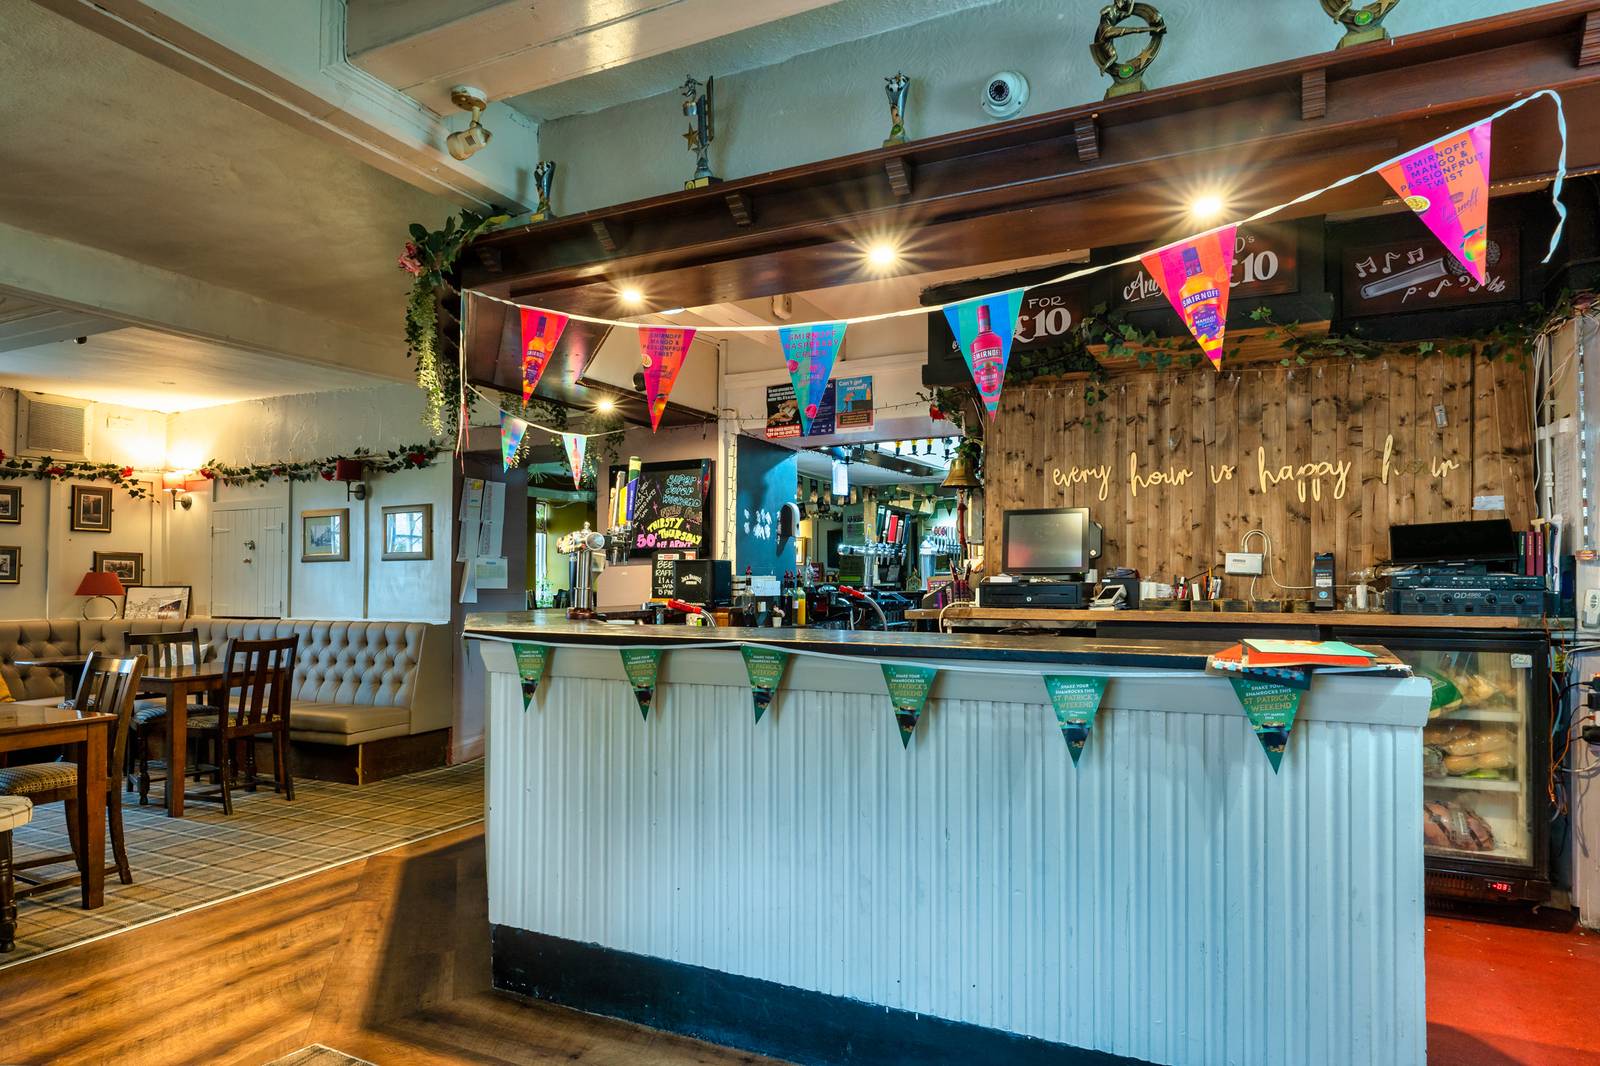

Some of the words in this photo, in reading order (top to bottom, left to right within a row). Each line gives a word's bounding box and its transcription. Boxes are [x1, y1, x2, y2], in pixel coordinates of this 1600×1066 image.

[1406, 140, 1467, 172] SMIRNOFF
[1411, 155, 1456, 179] MANGO
[1460, 150, 1467, 158] &
[1400, 152, 1484, 192] PASSIONFRUIT
[1427, 169, 1464, 190] TWIST
[1028, 295, 1066, 309] FOR
[1182, 289, 1219, 308] SMIRNOFF
[1013, 307, 1072, 343] £10
[1053, 464, 1112, 501] every
[1130, 452, 1193, 497] hour
[1210, 464, 1235, 484] is
[1258, 446, 1351, 503] happy
[646, 517, 684, 533] THIRSTY
[655, 569, 674, 577] RAFF
[657, 560, 674, 569] BEE
[1252, 701, 1292, 713] WEEKEND
[1256, 693, 1297, 704] PATRICK'S
